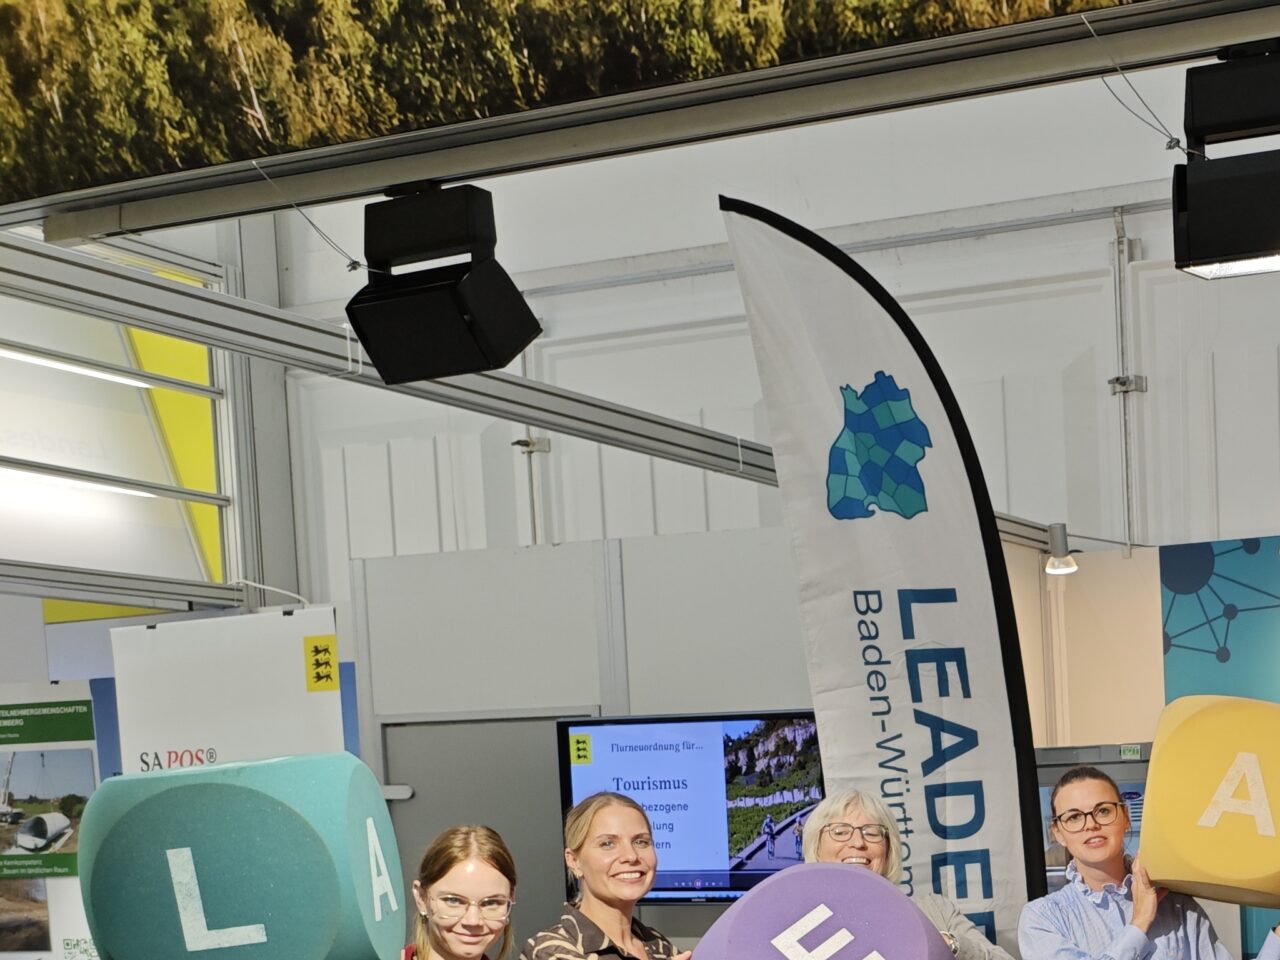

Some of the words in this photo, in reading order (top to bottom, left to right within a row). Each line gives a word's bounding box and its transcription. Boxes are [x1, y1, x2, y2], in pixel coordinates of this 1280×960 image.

[611, 742, 680, 754] Flurneuordnung
[613, 776, 688, 791] Tourismus
[1196, 752, 1276, 837] A
[640, 801, 689, 815] bezogene
[652, 820, 674, 833] lung
[366, 817, 398, 922] A
[166, 847, 267, 952] L
